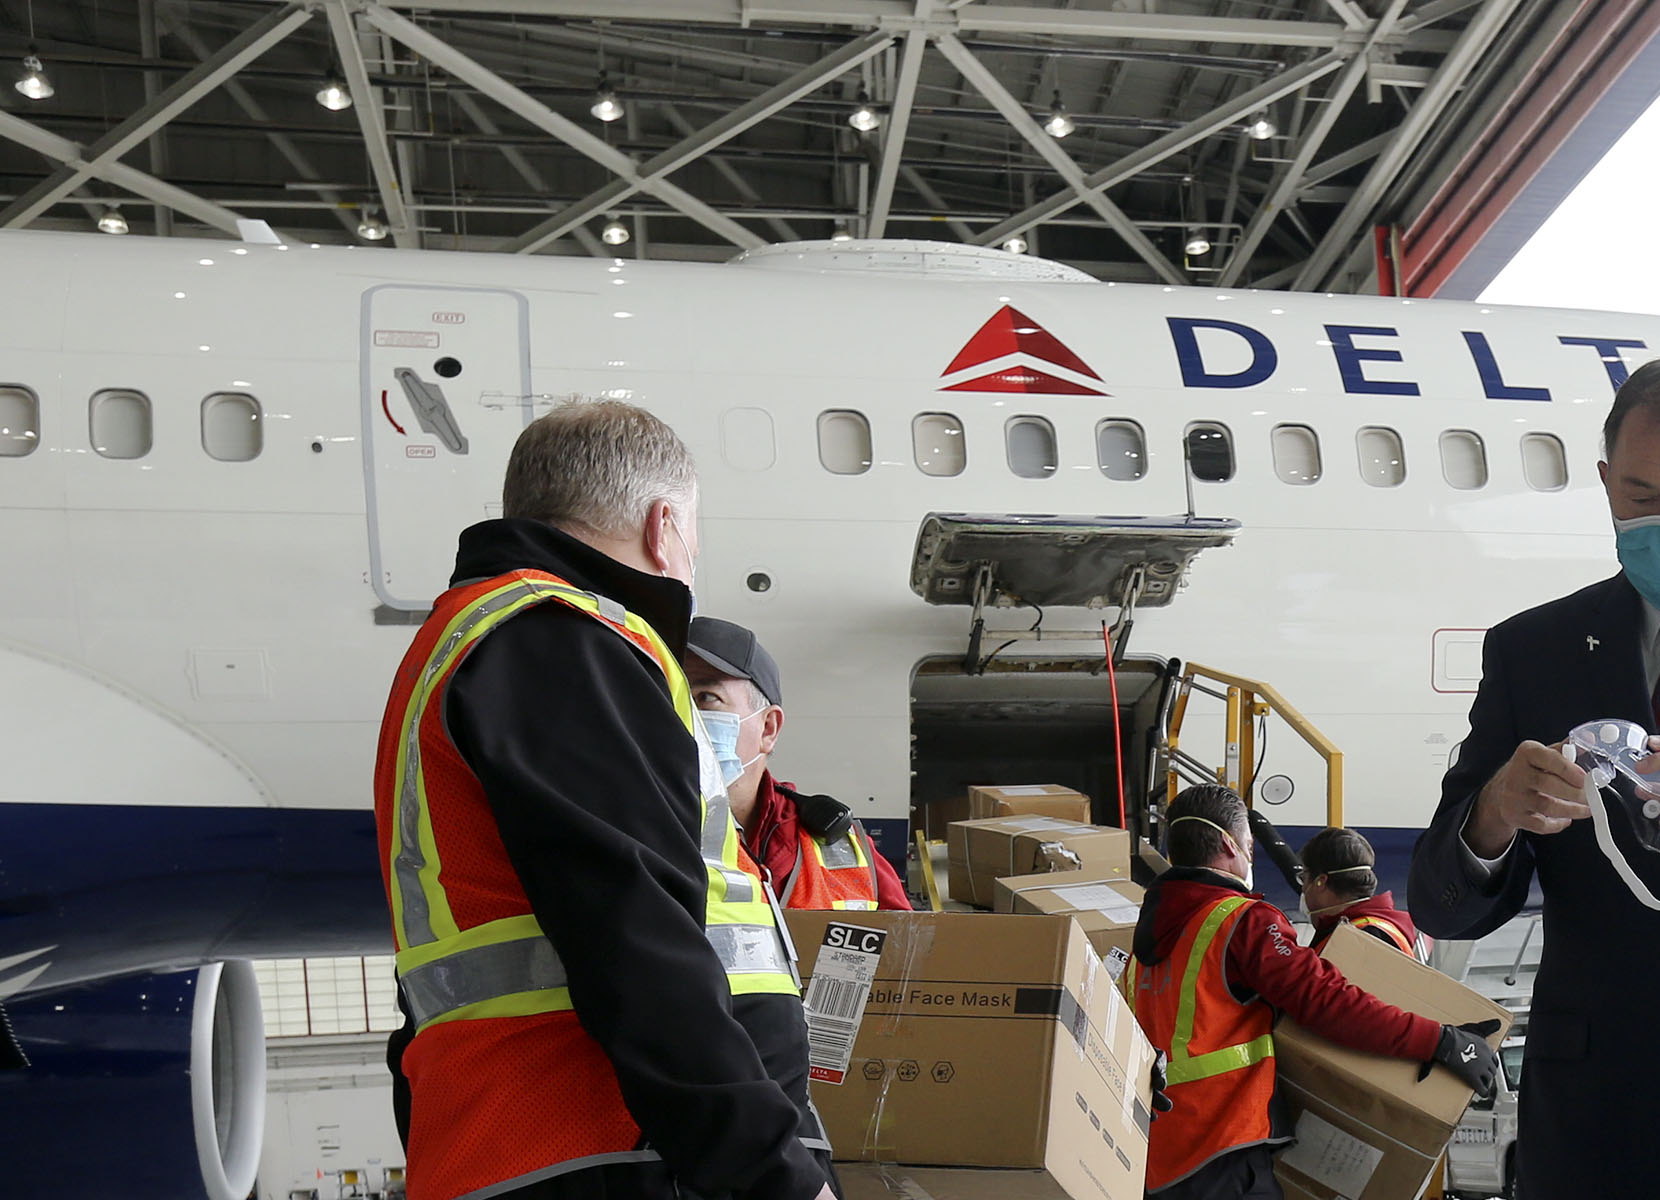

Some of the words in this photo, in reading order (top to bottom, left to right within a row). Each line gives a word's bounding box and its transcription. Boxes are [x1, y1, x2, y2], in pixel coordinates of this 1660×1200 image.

[827, 927, 880, 953] SLC
[1266, 923, 1292, 957] RAMP
[1110, 948, 1129, 963] SLC
[866, 989, 903, 1004] able
[909, 990, 955, 1006] Face
[961, 991, 1011, 1007] Mask
